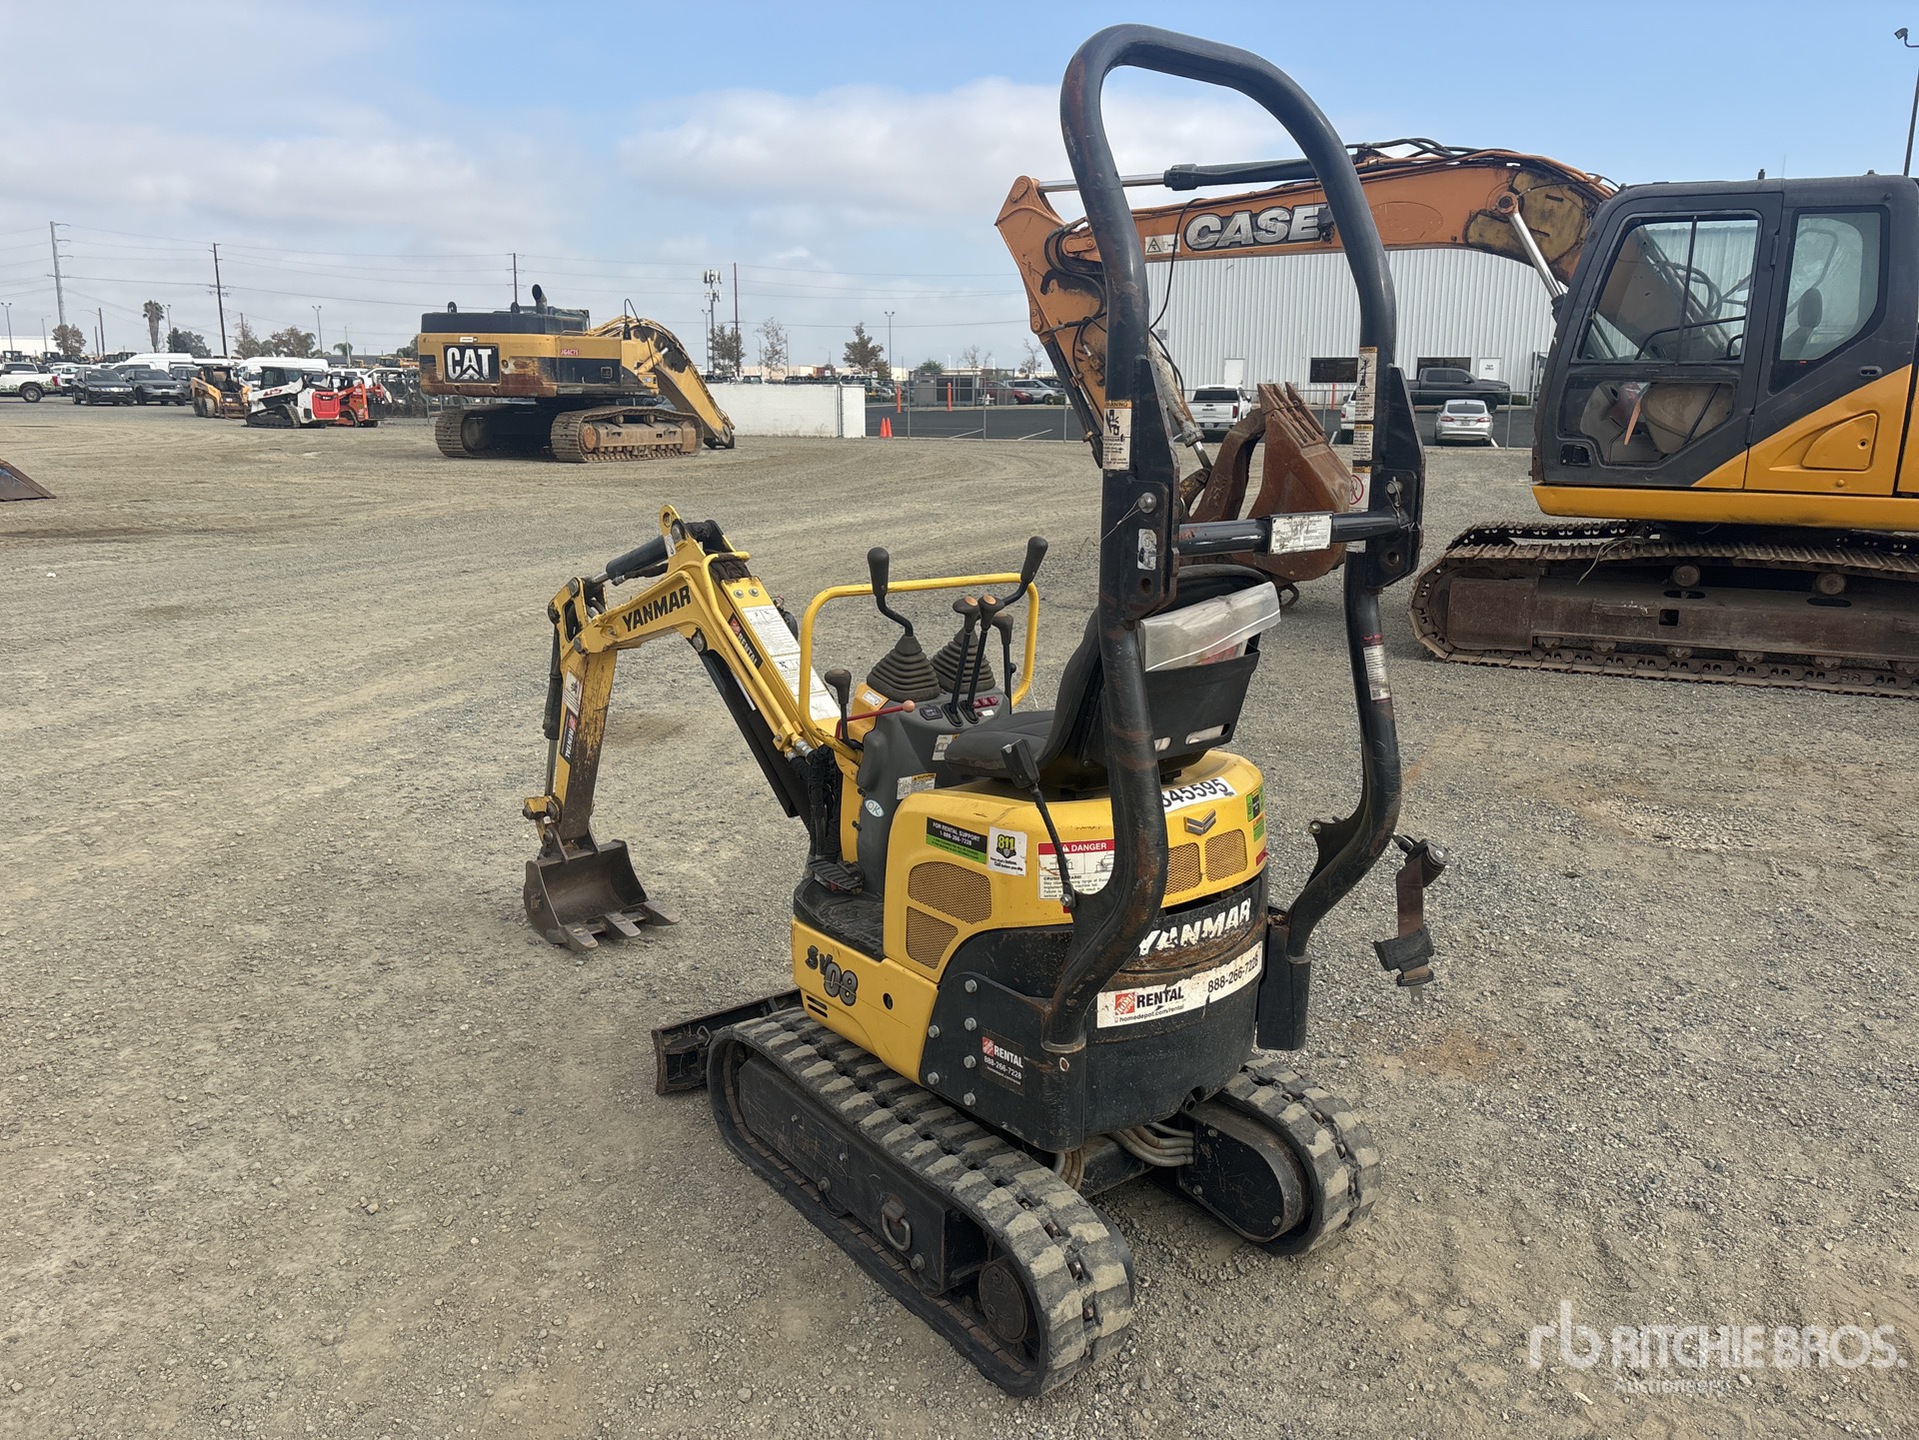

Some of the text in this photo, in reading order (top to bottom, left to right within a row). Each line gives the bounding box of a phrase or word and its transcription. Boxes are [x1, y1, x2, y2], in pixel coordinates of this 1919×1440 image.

[1184, 204, 1328, 250] CASE
[446, 347, 493, 381] CAT
[622, 585, 692, 632] YANMAR
[565, 728, 575, 758] RENTAL
[942, 824, 958, 835] RENTAL
[959, 830, 981, 842] SUPPORT
[998, 834, 1015, 851] 811
[1071, 842, 1107, 852] DANGER
[1138, 898, 1252, 957] YANMAR
[1136, 987, 1185, 1009] RENTAL
[1119, 1003, 1185, 1023] homedepot.com/rental
[994, 1044, 1024, 1069] RENTAL
